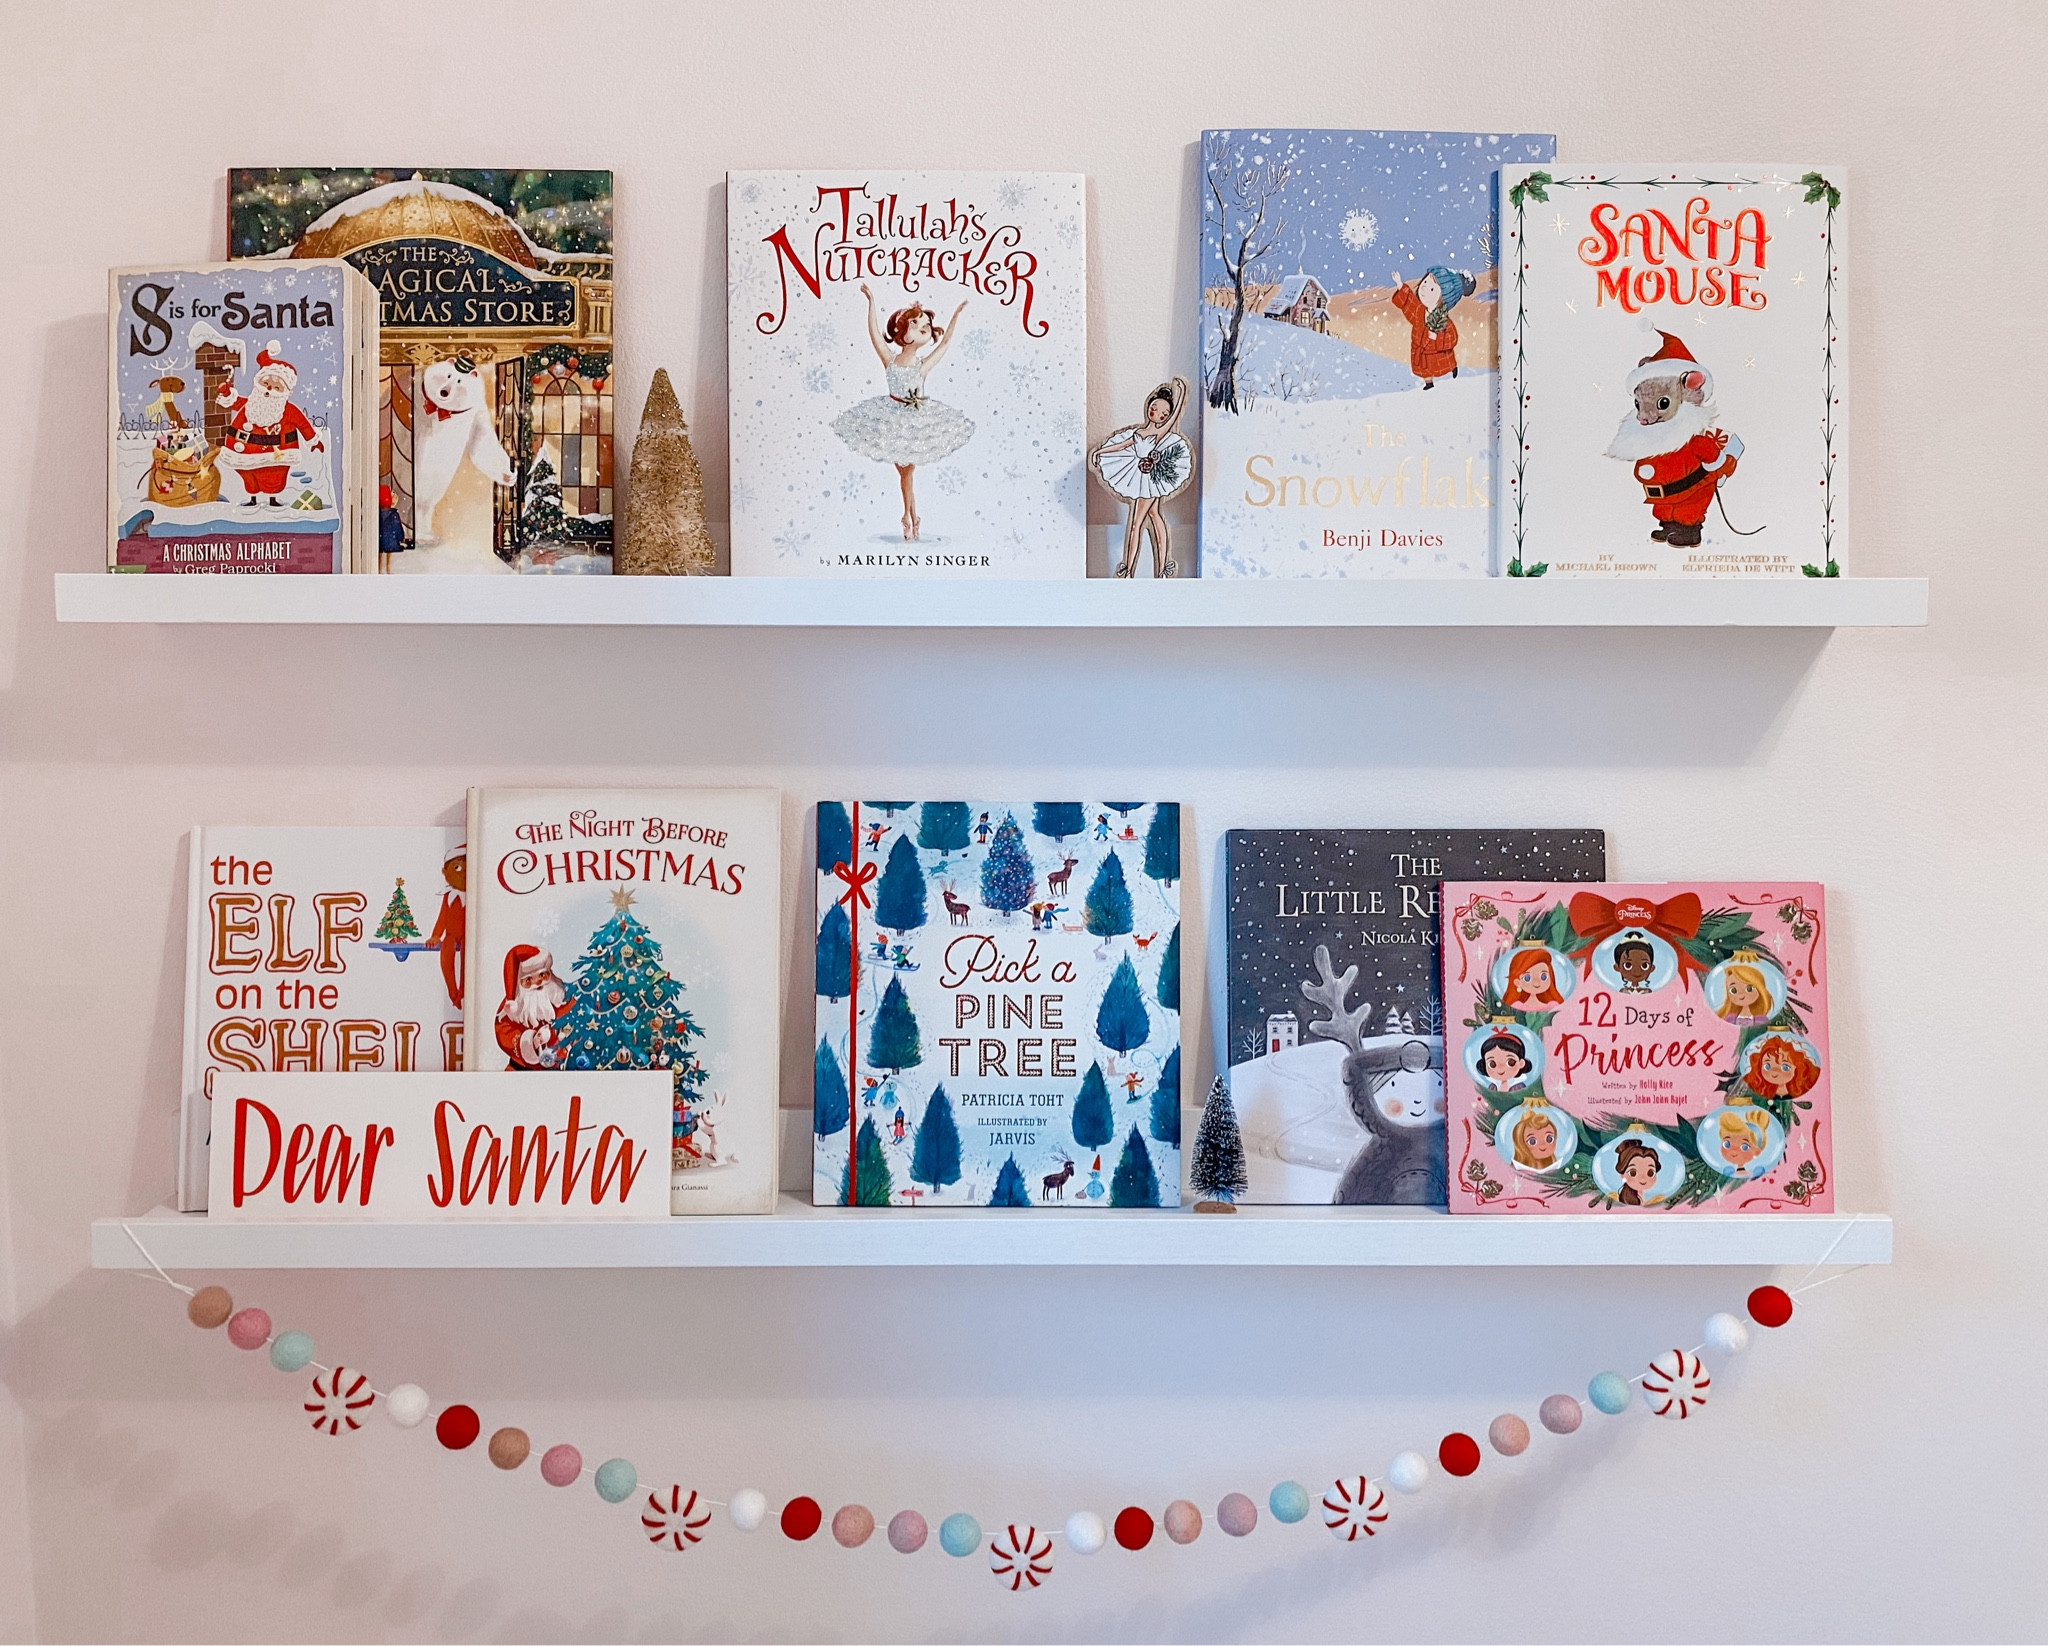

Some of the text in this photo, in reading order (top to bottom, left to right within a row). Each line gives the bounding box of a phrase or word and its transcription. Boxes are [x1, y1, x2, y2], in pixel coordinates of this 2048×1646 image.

[809, 181, 988, 246] Tallulah's
[1578, 197, 1774, 271] SANTA
[400, 246, 437, 262] THE
[1596, 266, 1769, 314] MOUSE
[130, 283, 334, 357] S is for Santa
[464, 298, 554, 323] STORE
[1362, 423, 1407, 447] The
[1244, 454, 1495, 508] Snowflak
[163, 541, 292, 562] A CHRISTMAS ALPHABET
[1323, 529, 1443, 551] Benji Davies
[173, 562, 277, 574] by Greg Paprocki
[820, 554, 991, 567] by MARILYN SINGER
[1555, 563, 1659, 572] MICHAEL BROWN
[1600, 554, 1615, 562] BY
[1682, 564, 1796, 573] ELFRIEDA DE WITT
[1688, 555, 1789, 563] ILLUSTRATED BY
[515, 809, 729, 849] THE NIGHT BEFORE
[210, 854, 273, 886] the
[497, 849, 746, 895] CHRISTMAS
[1390, 853, 1443, 878] THE
[1275, 884, 1386, 918] LITTLE
[208, 892, 368, 975] ELF
[1361, 931, 1417, 946] NICOLA
[939, 934, 1078, 990] Pick a
[215, 978, 339, 1010] on the
[956, 994, 1064, 1030] PINE
[1578, 992, 1695, 1029] 12 Days of
[939, 1038, 1077, 1077] TREE
[1554, 1033, 1723, 1085] Princess
[1629, 1082, 1637, 1091] by
[1639, 1079, 1658, 1091] Holly
[1659, 1079, 1674, 1089] Rice
[961, 1094, 1065, 1106] PATRICIA TOHT
[1587, 1094, 1688, 1106] Illustrated by John John Bajet
[977, 1117, 1048, 1126] ILLUSTRATED BY
[232, 1095, 648, 1208] Dear Santa
[989, 1132, 1036, 1146] JARVIS
